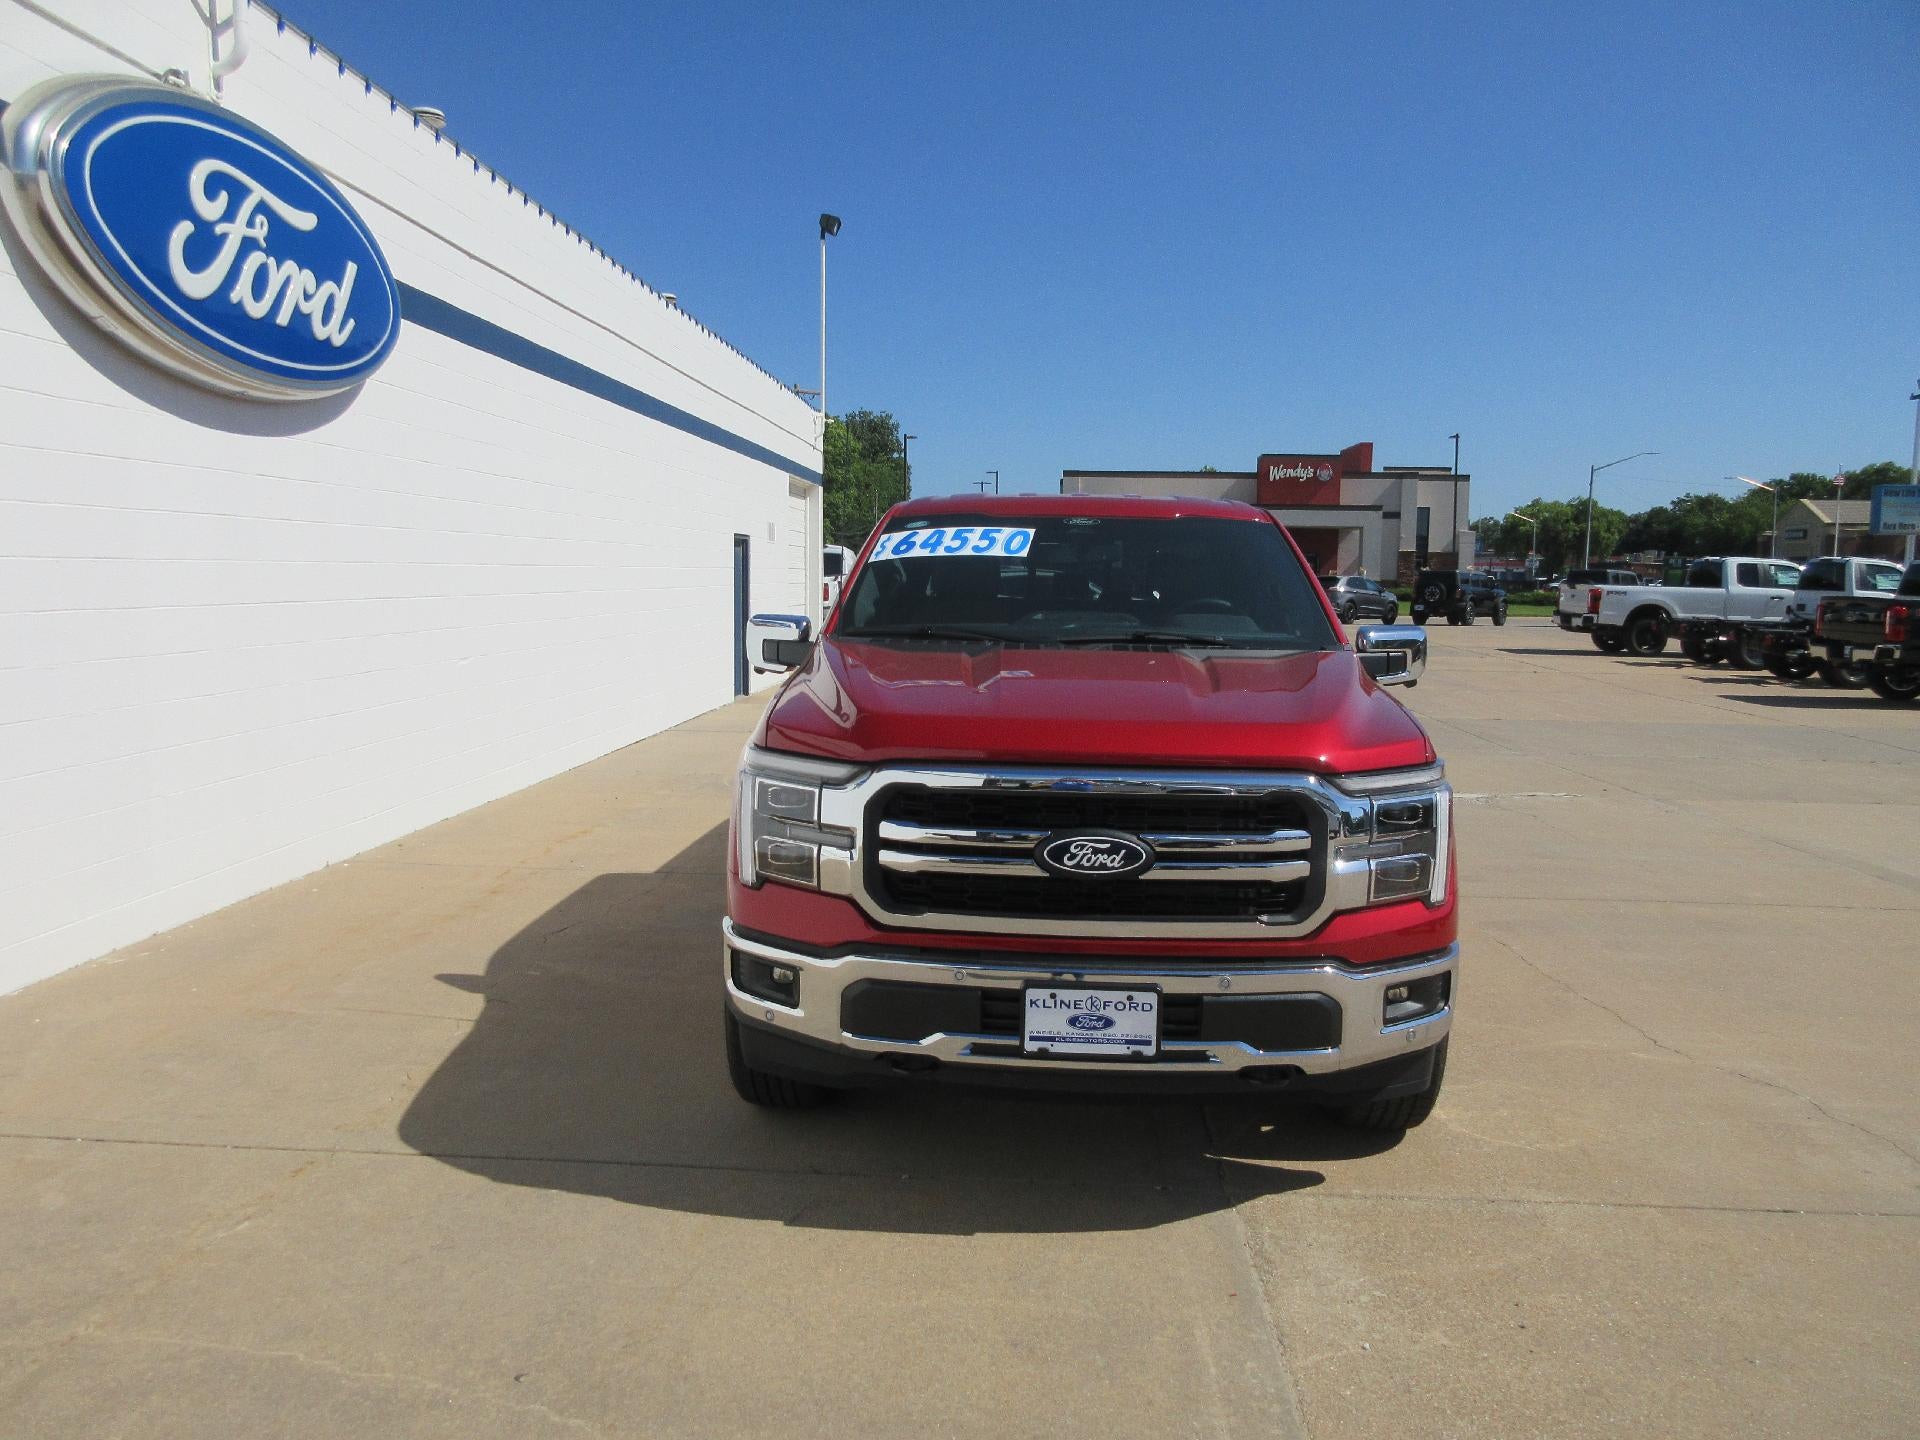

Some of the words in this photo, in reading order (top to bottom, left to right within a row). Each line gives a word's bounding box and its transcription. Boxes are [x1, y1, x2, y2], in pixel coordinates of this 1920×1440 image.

[169, 158, 358, 348] Ford
[1269, 463, 1314, 481] Wendy's
[873, 528, 1032, 560] $64550
[1063, 841, 1127, 867] Ford
[1029, 998, 1084, 1010] KLINE
[1102, 1001, 1154, 1012] FORD
[1076, 1015, 1105, 1028] Ford
[1055, 1036, 1125, 1044] KLINEMOTORS.COM
